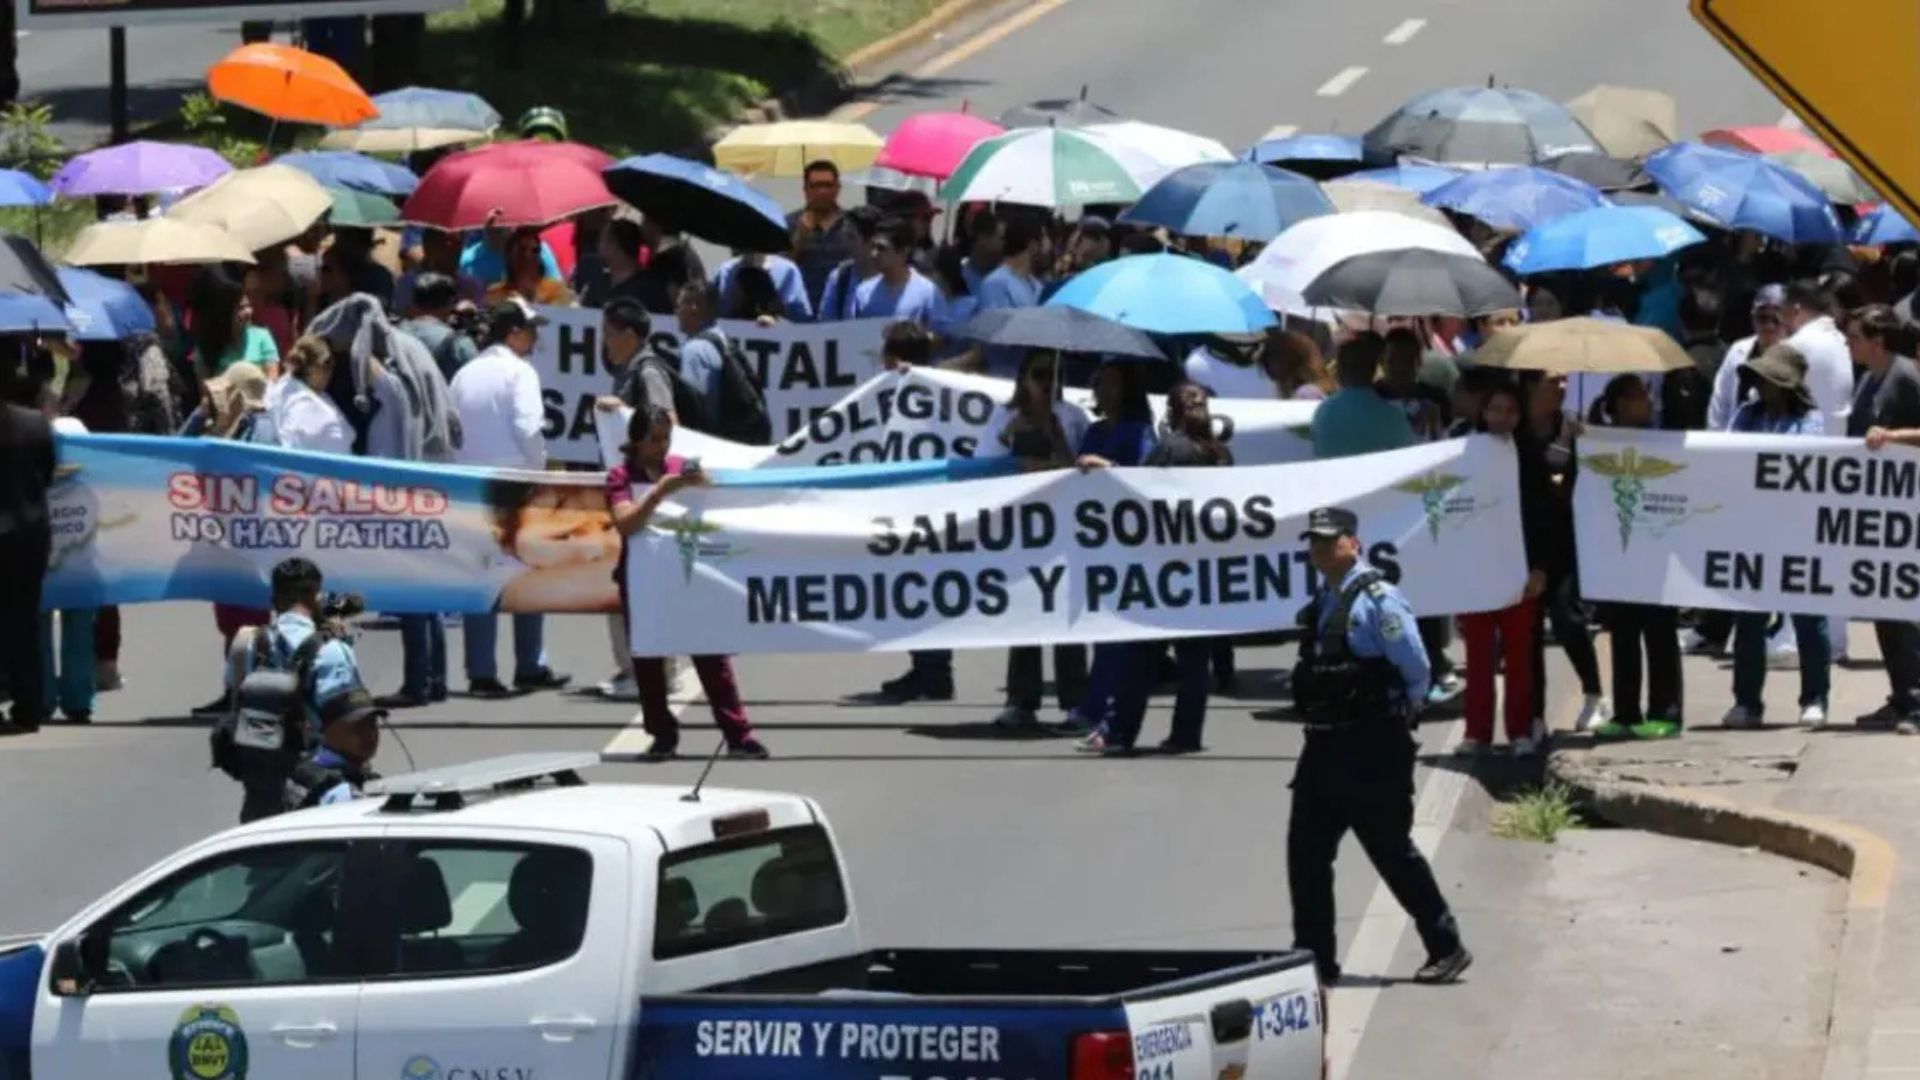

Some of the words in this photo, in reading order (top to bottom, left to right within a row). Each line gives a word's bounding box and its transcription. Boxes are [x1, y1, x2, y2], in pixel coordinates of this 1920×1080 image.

[559, 324, 856, 390] HSTAL
[777, 384, 995, 455] OLEGIO
[169, 472, 256, 514] SIN
[271, 474, 447, 515] SALUD
[1754, 452, 1920, 499] EXIGIM
[172, 513, 224, 541] NO
[230, 519, 305, 548] HAY
[317, 519, 450, 549] PATRIA
[867, 500, 1057, 556] SALUD
[1074, 494, 1277, 548] SOMOS
[746, 567, 1010, 624] MEDICOS
[1028, 564, 1066, 613] Y
[1086, 542, 1402, 612] PACIENTS
[1704, 551, 1763, 591] EN
[1780, 556, 1833, 594] EL
[696, 1020, 802, 1057] SERVIR
[811, 1022, 833, 1057] Y
[839, 1023, 1001, 1062] PROTEGER
